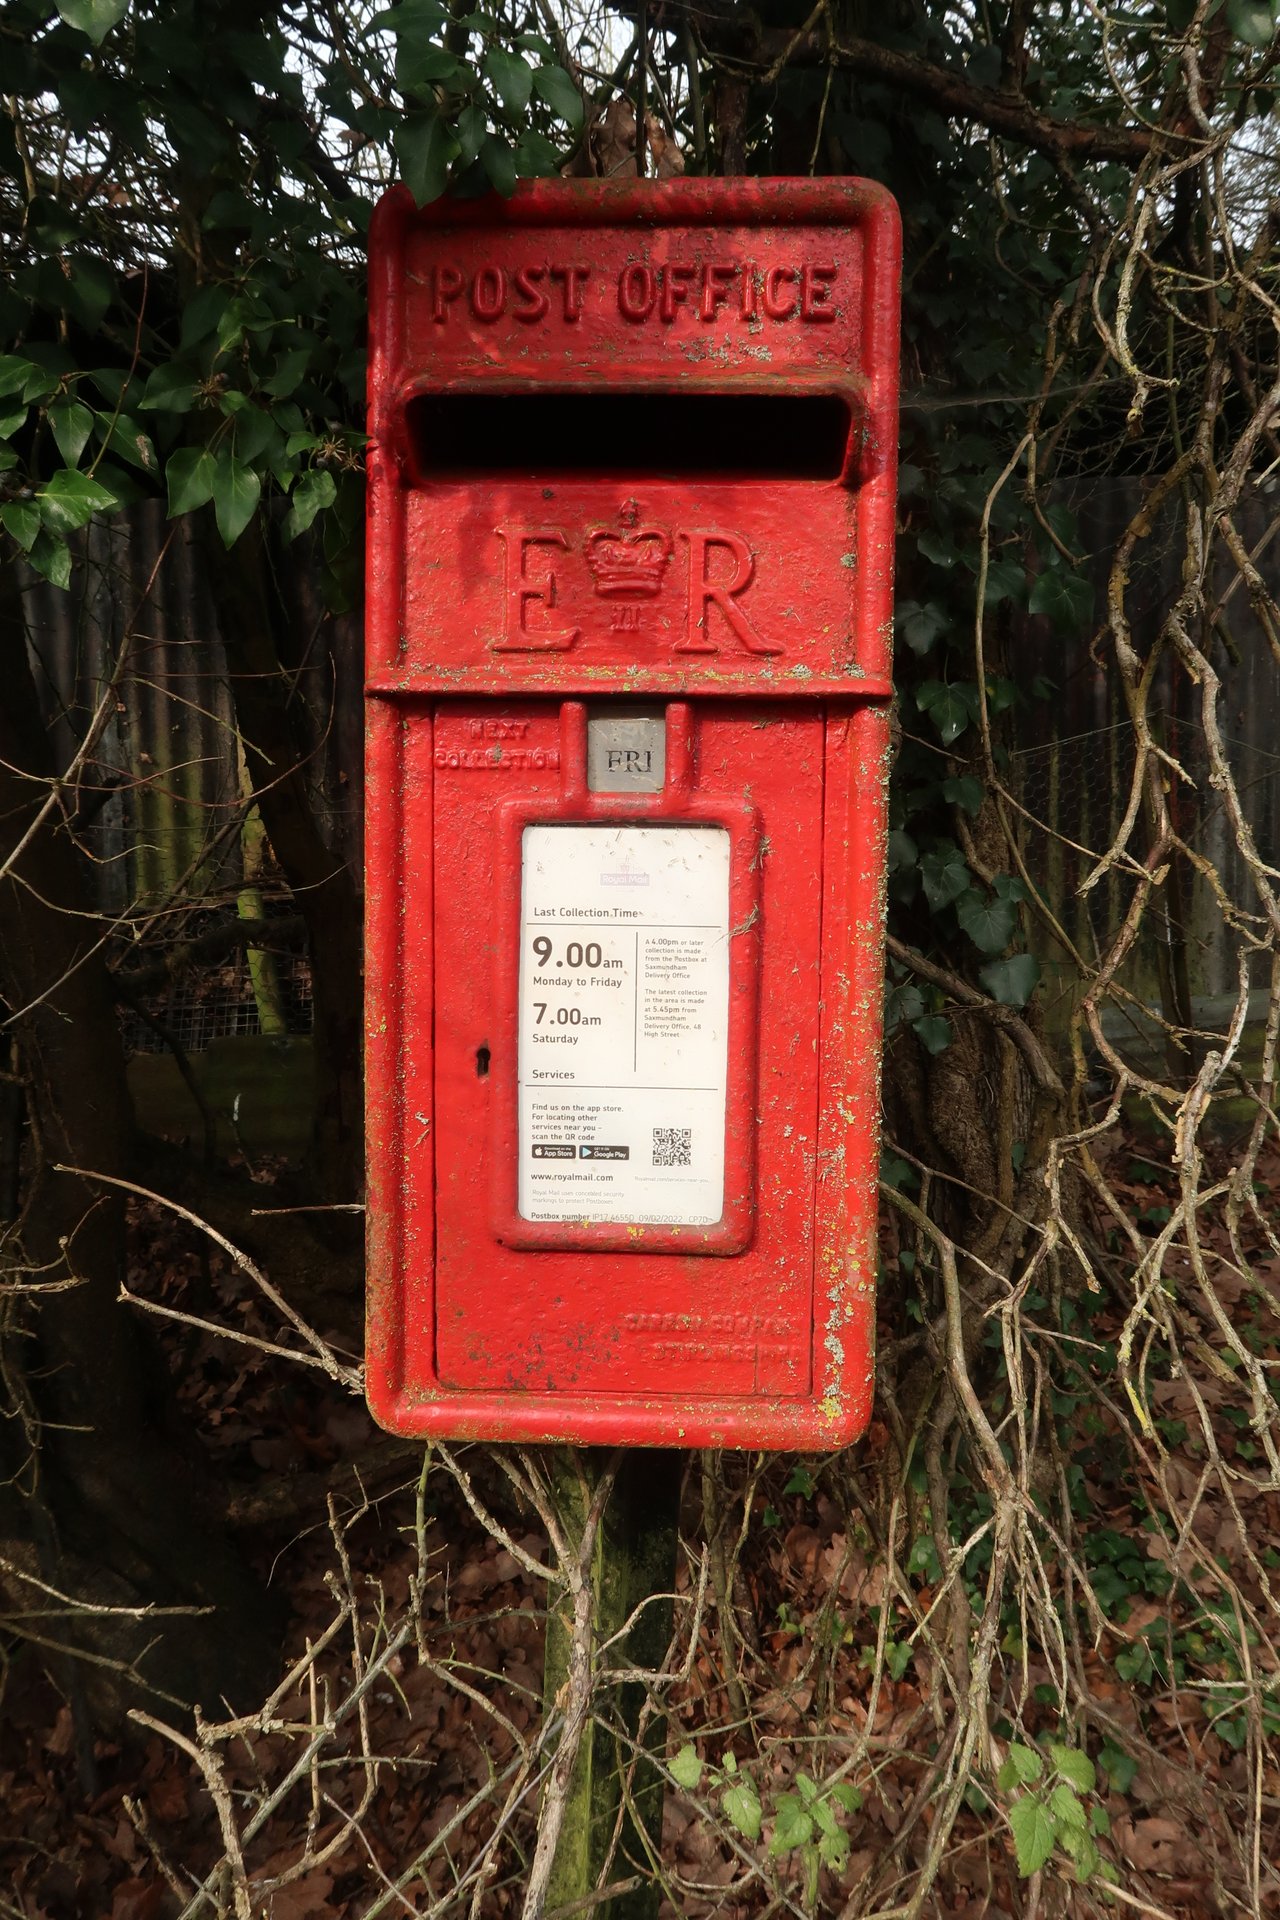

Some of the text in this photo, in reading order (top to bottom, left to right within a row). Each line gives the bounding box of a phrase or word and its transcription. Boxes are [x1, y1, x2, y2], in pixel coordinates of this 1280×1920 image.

[432, 259, 839, 324] POST OFFICE
[492, 521, 582, 655] E
[672, 525, 786, 656] R
[469, 718, 528, 739] NEXT
[434, 747, 560, 771] COLLECTION
[606, 750, 655, 773] FRI
[533, 907, 639, 918] Last Collection Time
[651, 938, 679, 946] 4.00pm
[532, 936, 624, 969] 9.00am
[533, 976, 623, 989] Monday to Friday
[532, 1002, 602, 1026] 7.00am
[532, 1033, 579, 1046] Saturday
[532, 1069, 576, 1079] Services
[531, 1103, 549, 1111] Find
[531, 1113, 544, 1121] For
[546, 1114, 576, 1122] locating
[577, 1133, 595, 1141] code
[593, 1151, 627, 1159] Google Play
[530, 1172, 613, 1182] www.royalmail.com
[531, 1212, 560, 1220] Postbox
[561, 1213, 590, 1221] number
[592, 1213, 609, 1221] IP17
[639, 1214, 683, 1223] 09/02/2022
